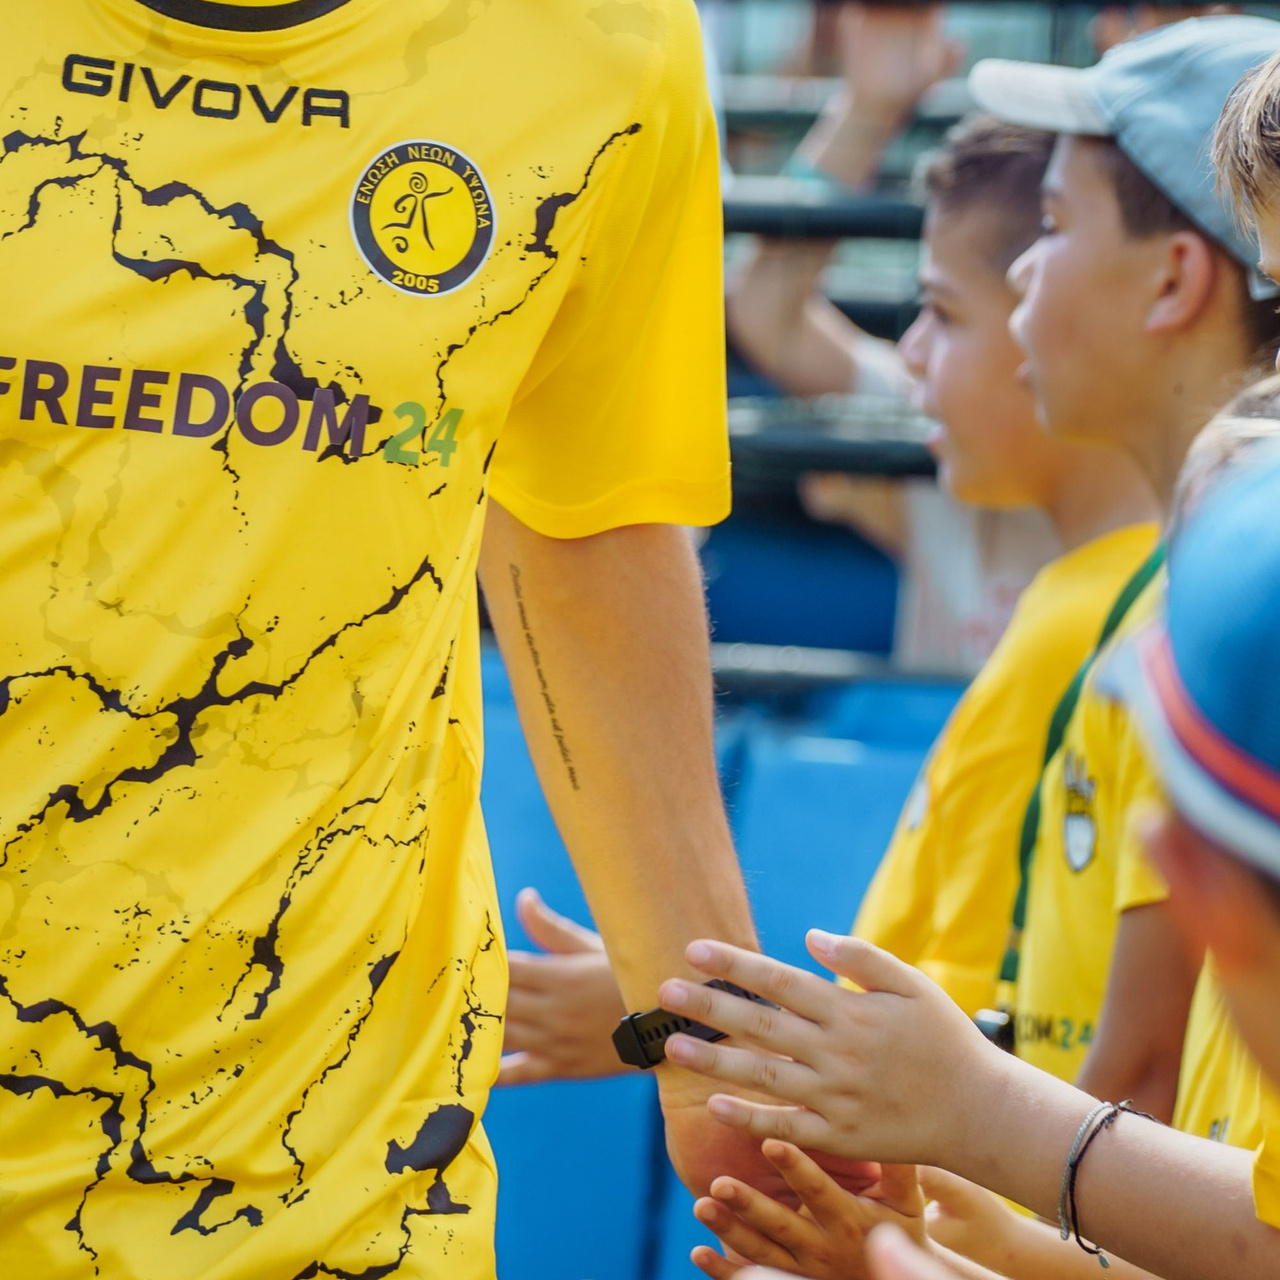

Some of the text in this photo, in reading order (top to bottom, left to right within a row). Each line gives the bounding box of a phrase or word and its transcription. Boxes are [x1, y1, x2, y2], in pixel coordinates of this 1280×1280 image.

[62, 53, 350, 129] GIVOVA
[356, 145, 492, 230] ΕΝΩΣΗ ΝΕΩΝ ΥΨΩΝΑ
[391, 270, 440, 294] 2005
